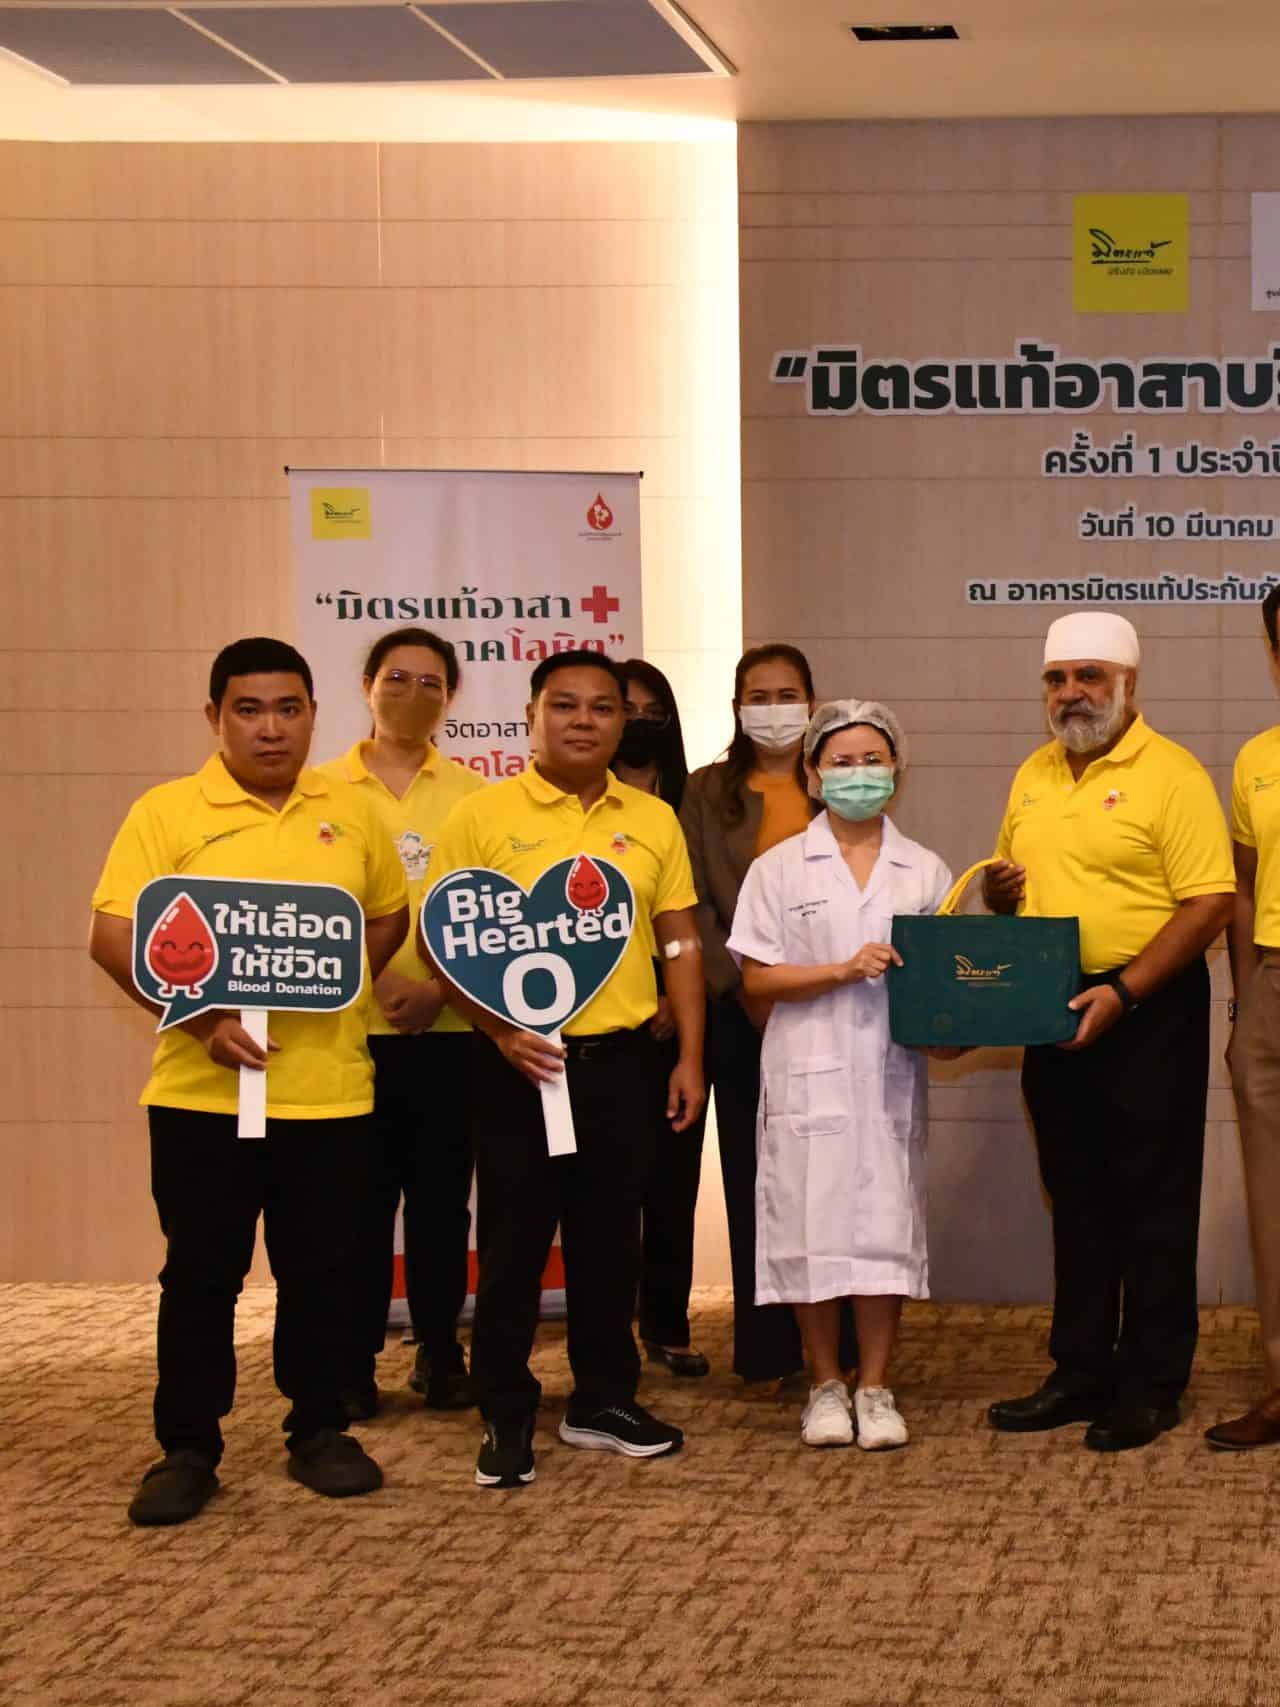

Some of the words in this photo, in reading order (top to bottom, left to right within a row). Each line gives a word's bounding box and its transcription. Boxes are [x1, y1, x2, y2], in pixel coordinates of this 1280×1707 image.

[1044, 432, 1134, 474] ครั้งที่
[1147, 446, 1161, 474] 1
[1081, 505, 1135, 537] วันที่
[1145, 516, 1175, 537] 10
[1186, 511, 1274, 537] มีนาคม
[967, 580, 996, 602] ณ
[212, 900, 352, 941] ให้เลือด
[446, 884, 525, 926] Big
[441, 901, 633, 960] Hearted
[230, 943, 342, 981] ให้ชีวิต
[227, 980, 271, 994] Blood
[275, 981, 342, 996] Donation
[502, 951, 577, 1026] O
